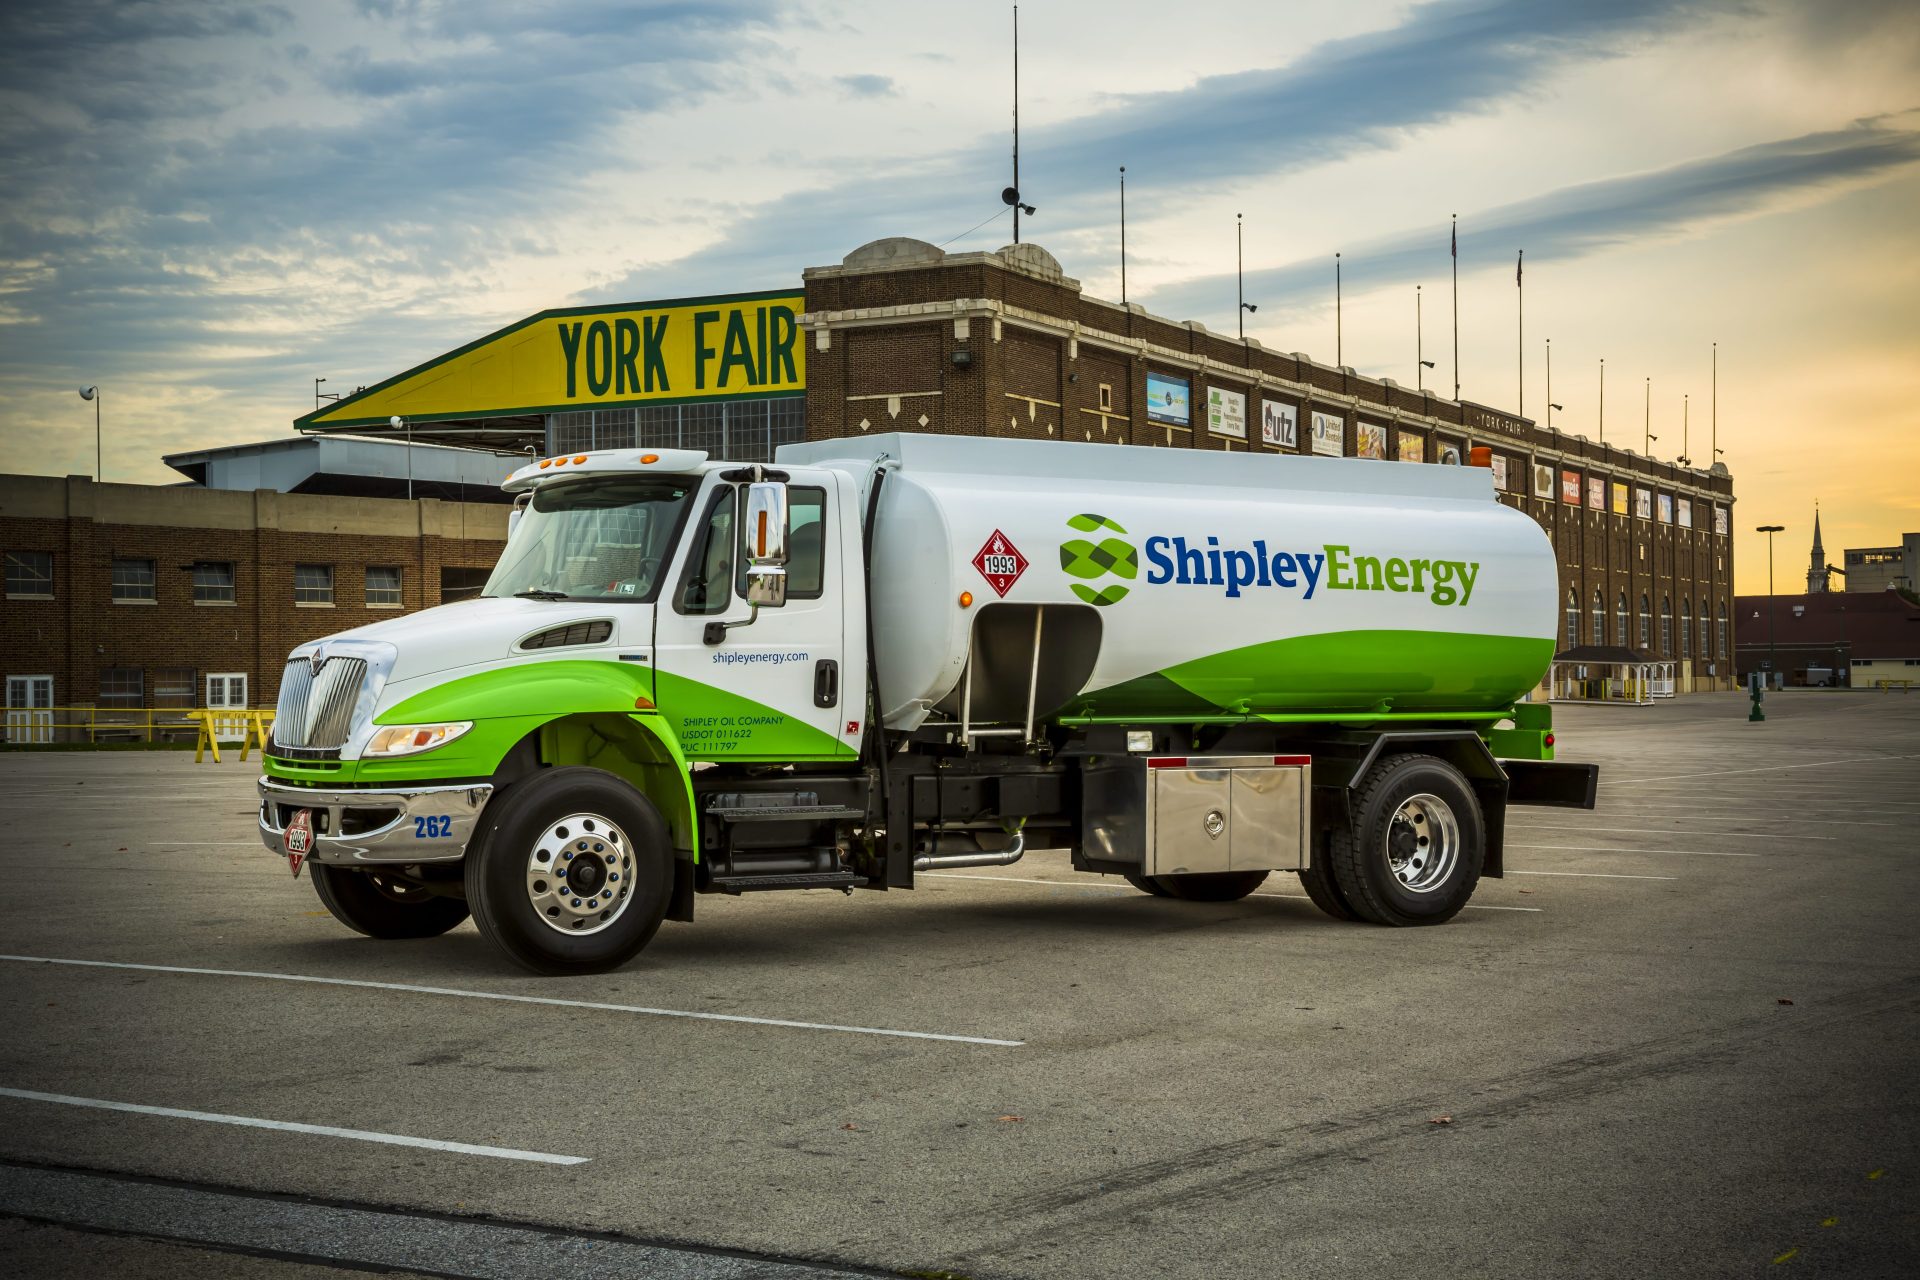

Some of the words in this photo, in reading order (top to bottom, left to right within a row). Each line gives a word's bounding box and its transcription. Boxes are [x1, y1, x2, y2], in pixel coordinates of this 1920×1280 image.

[557, 314, 671, 398] YORK
[694, 305, 798, 390] FAIR
[1326, 418, 1341, 432] United
[1481, 413, 1500, 430] YORK
[1505, 420, 1520, 436] FAIR
[1563, 478, 1579, 497] weis
[986, 556, 1015, 574] 1993
[1145, 536, 1480, 606] ShipleyEnergy
[999, 578, 1005, 587] 3
[712, 652, 809, 666] shipleyenergy.com
[683, 717, 718, 727] SHIPLEY
[720, 717, 735, 726] OIL
[737, 716, 784, 726] COMPANY
[682, 730, 713, 739] USDOT
[716, 729, 752, 739] 011622
[681, 743, 699, 752] PUC
[703, 742, 738, 751] 111797
[414, 815, 452, 838] 262
[290, 829, 306, 851] 1993
